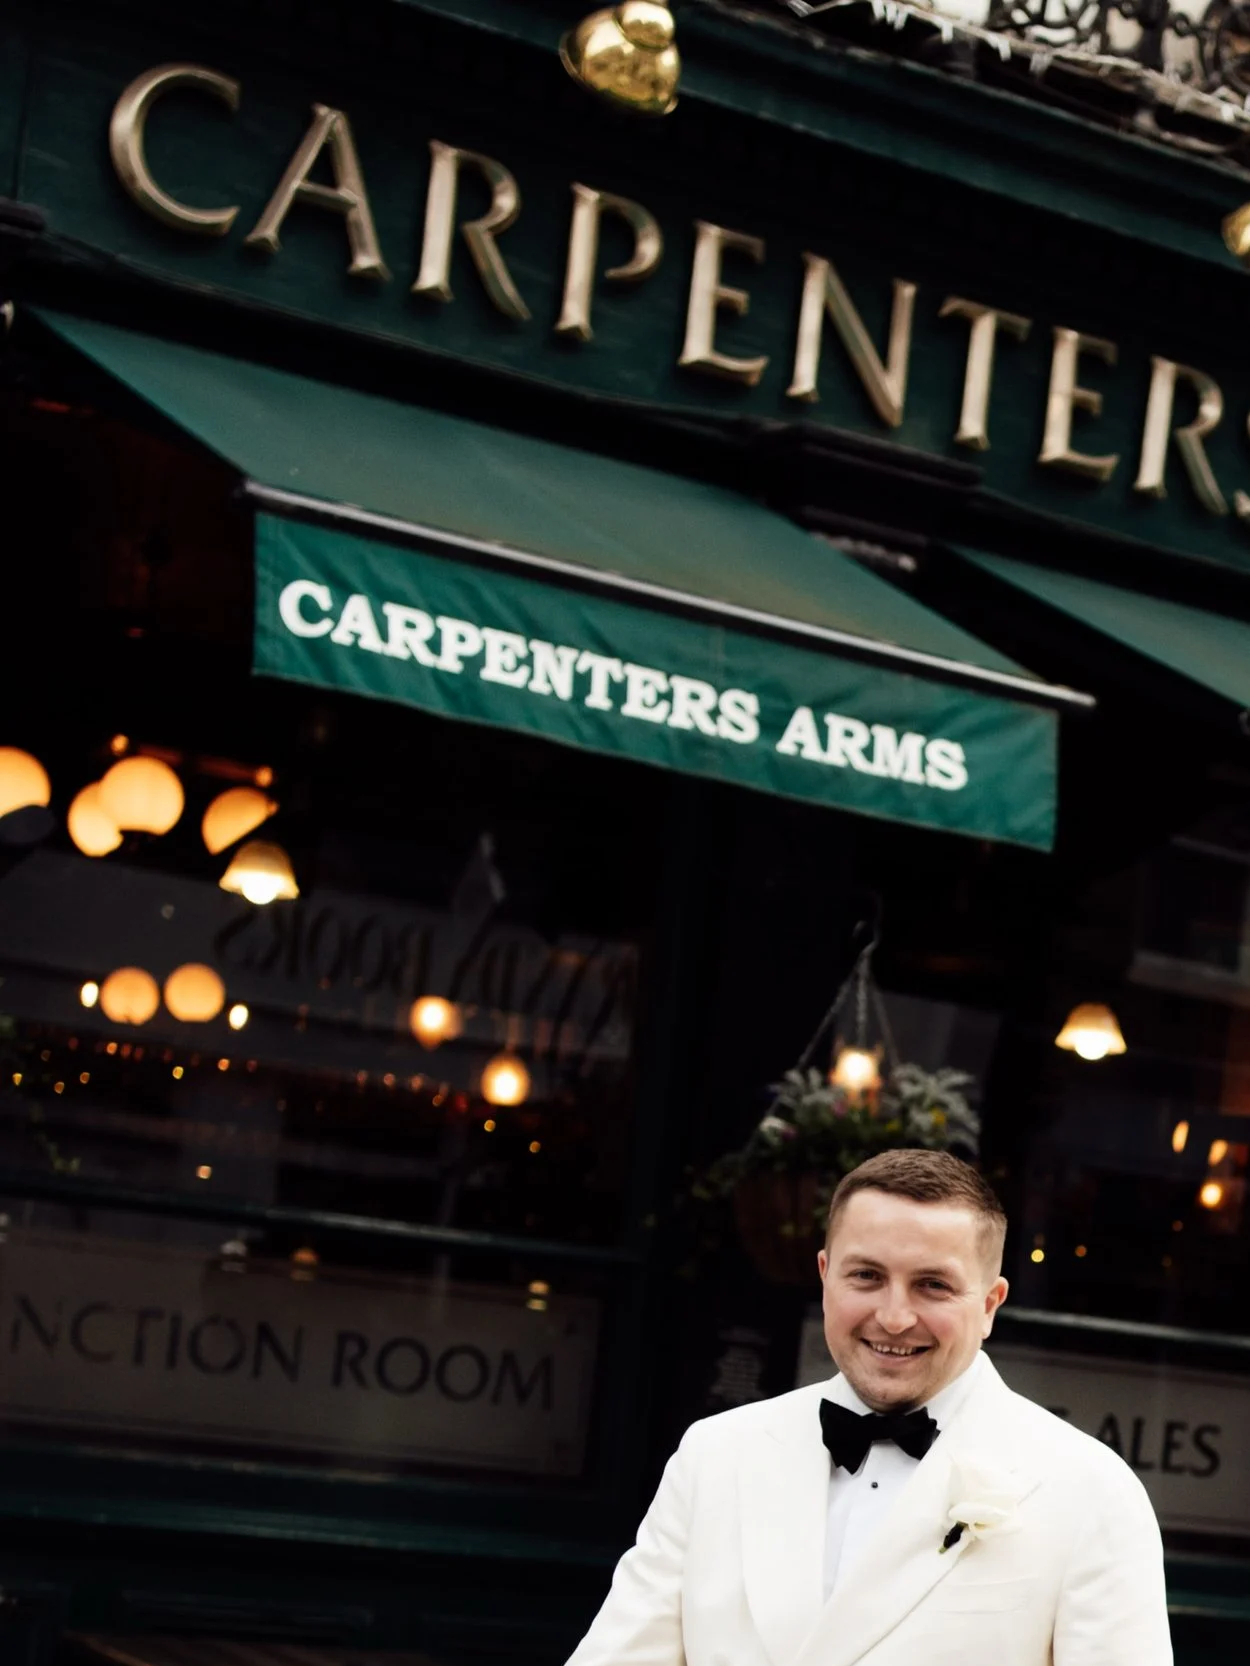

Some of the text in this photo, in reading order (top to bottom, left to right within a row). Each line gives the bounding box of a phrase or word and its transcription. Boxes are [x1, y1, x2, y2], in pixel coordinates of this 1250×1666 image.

[277, 578, 970, 791] CARPENTERS ARMS
[330, 1329, 555, 1411] ROOM
